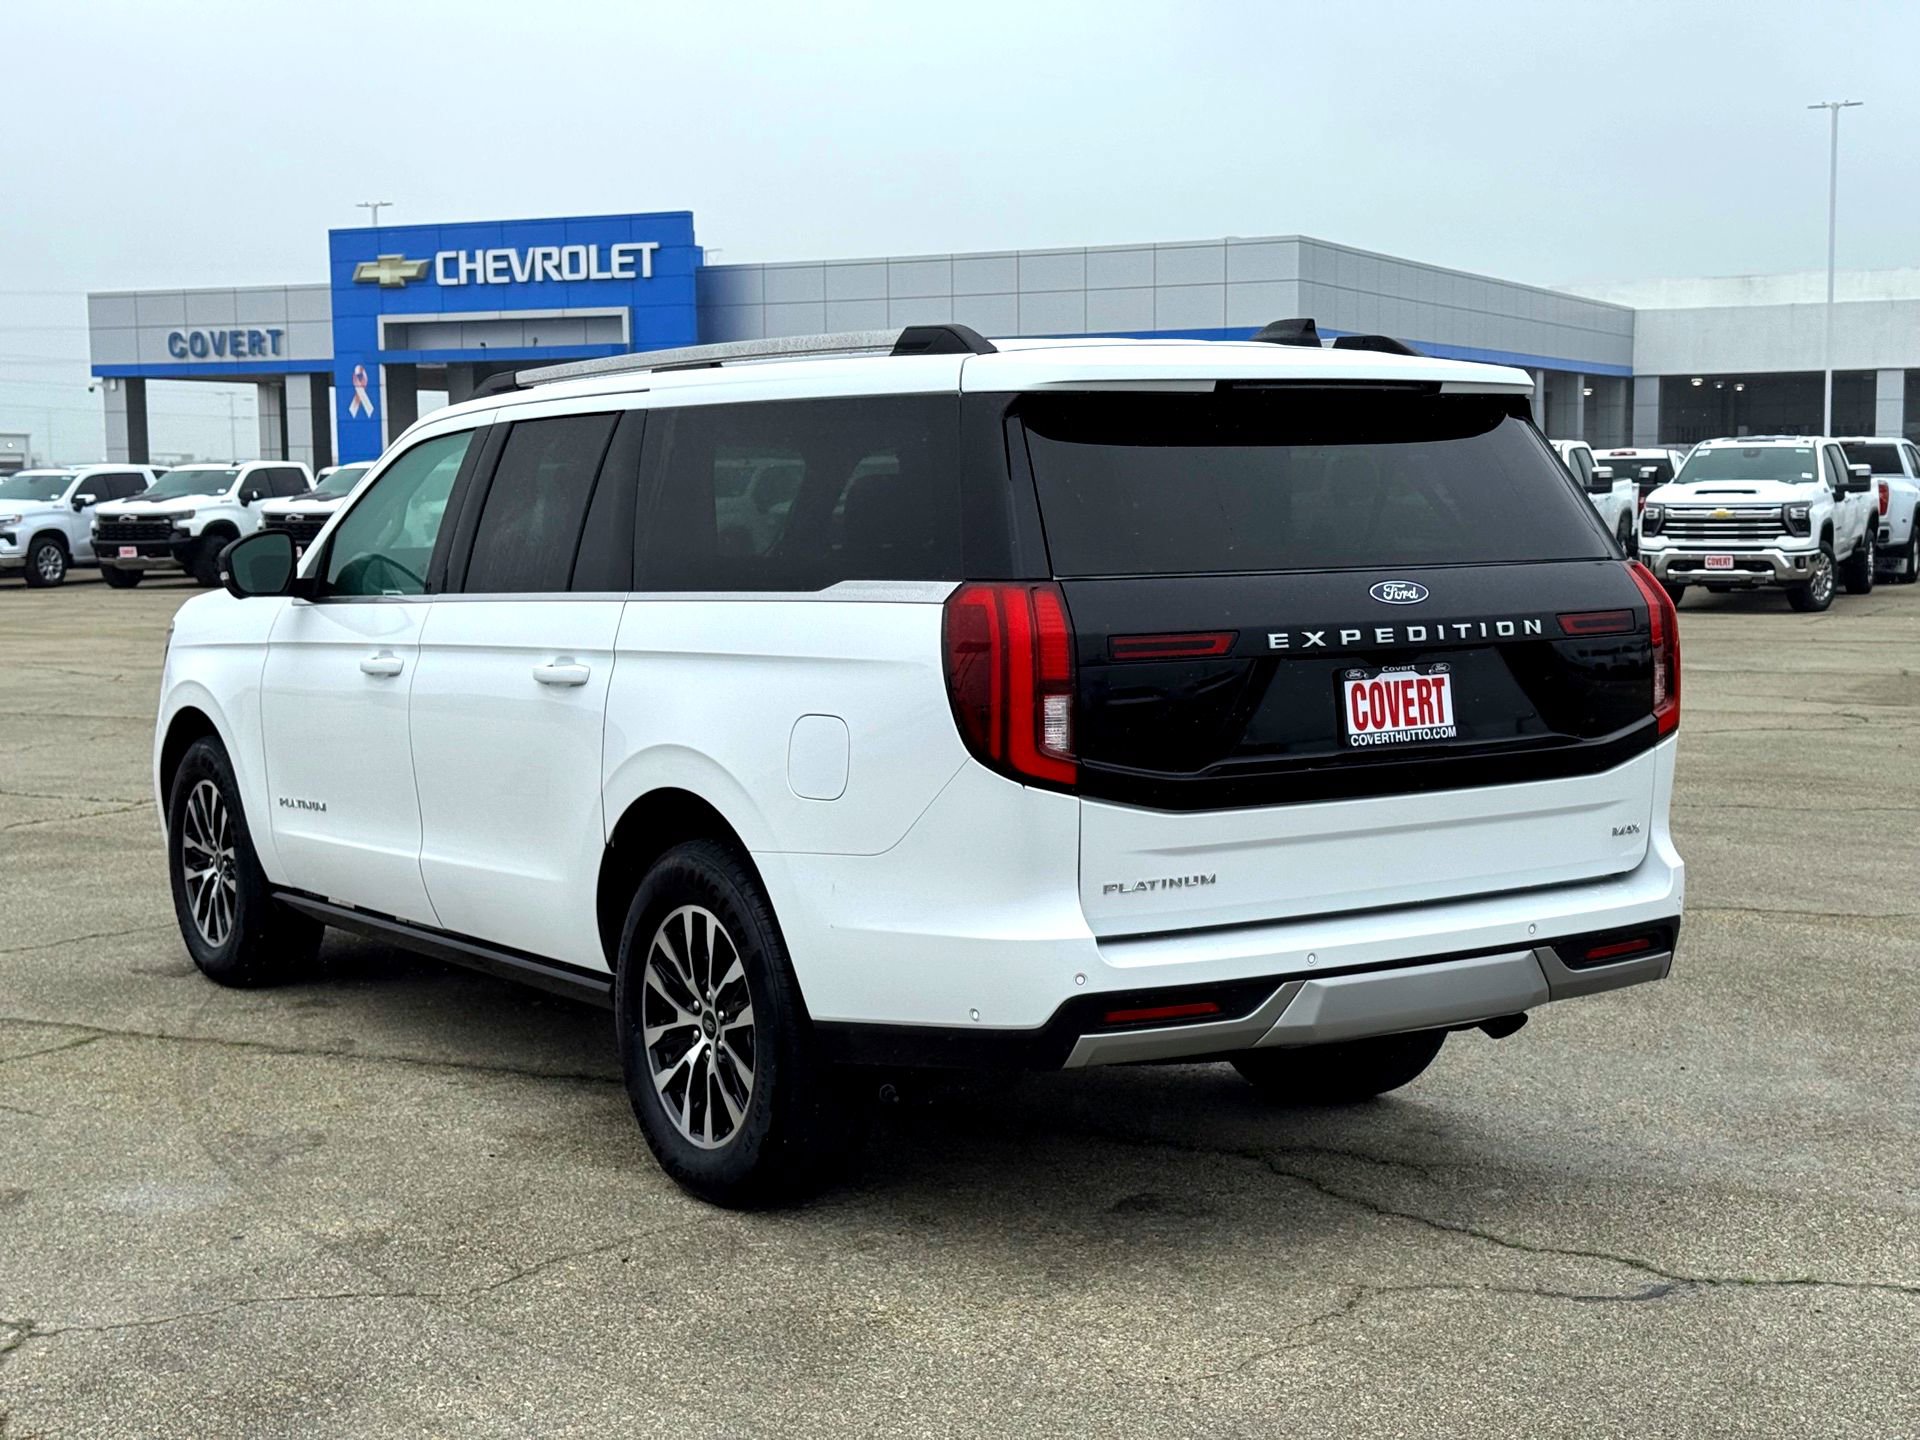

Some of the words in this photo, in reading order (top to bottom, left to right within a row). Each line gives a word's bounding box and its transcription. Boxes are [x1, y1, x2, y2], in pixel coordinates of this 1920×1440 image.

[435, 241, 660, 286] CHEVROLET
[168, 328, 284, 359] COVERT
[1383, 584, 1419, 600] Ford
[1267, 619, 1542, 649] EXPEDITION
[1382, 664, 1416, 672] Covert
[1351, 677, 1446, 732] COVERT
[1350, 726, 1457, 747] COVERTHUTTO.COM
[1102, 873, 1217, 895] PLATINUM
